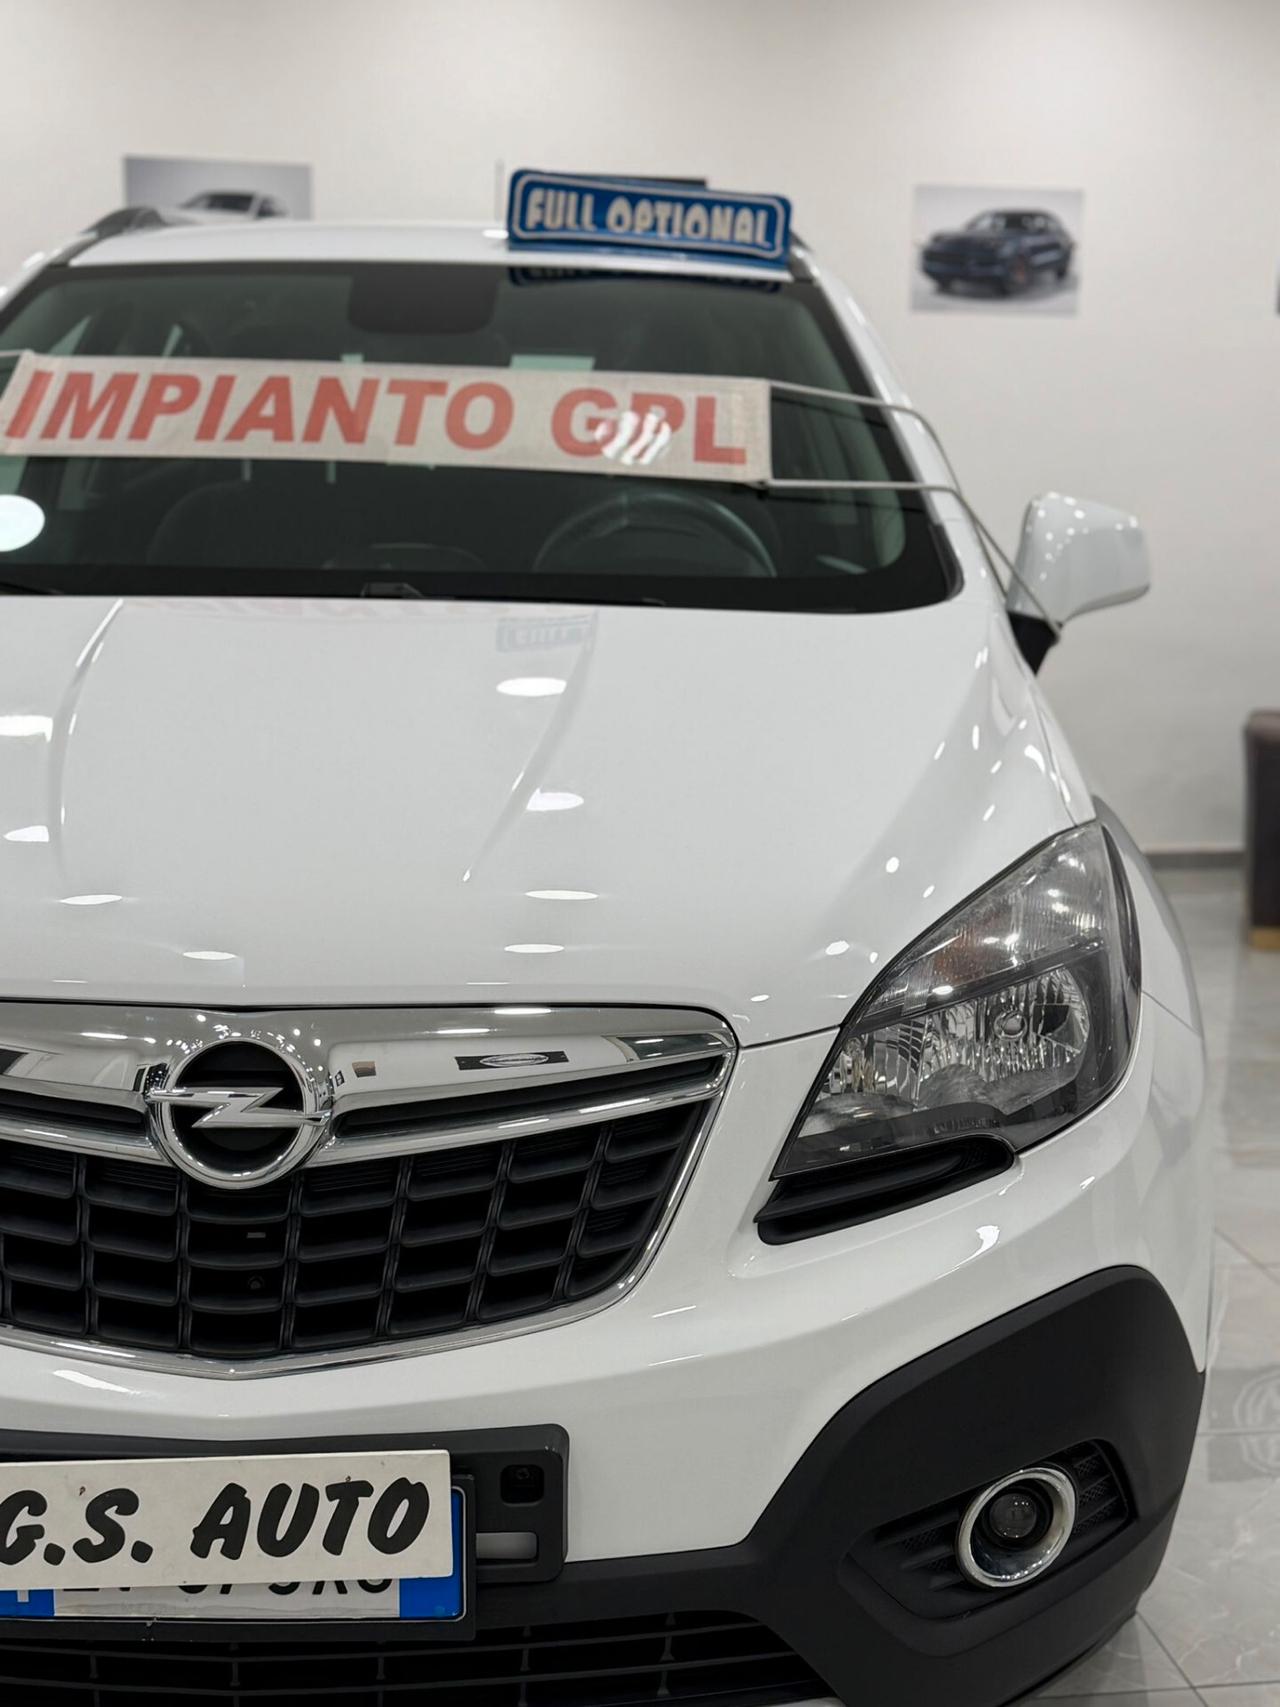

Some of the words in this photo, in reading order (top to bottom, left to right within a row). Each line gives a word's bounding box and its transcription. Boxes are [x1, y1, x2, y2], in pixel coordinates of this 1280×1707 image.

[525, 187, 598, 231] FULL
[606, 196, 772, 249] OPTIONAL
[5, 369, 514, 451] IMPIANTO
[551, 387, 747, 465] GPL
[0, 1488, 153, 1566] G.S.
[190, 1477, 430, 1560] AUTO
